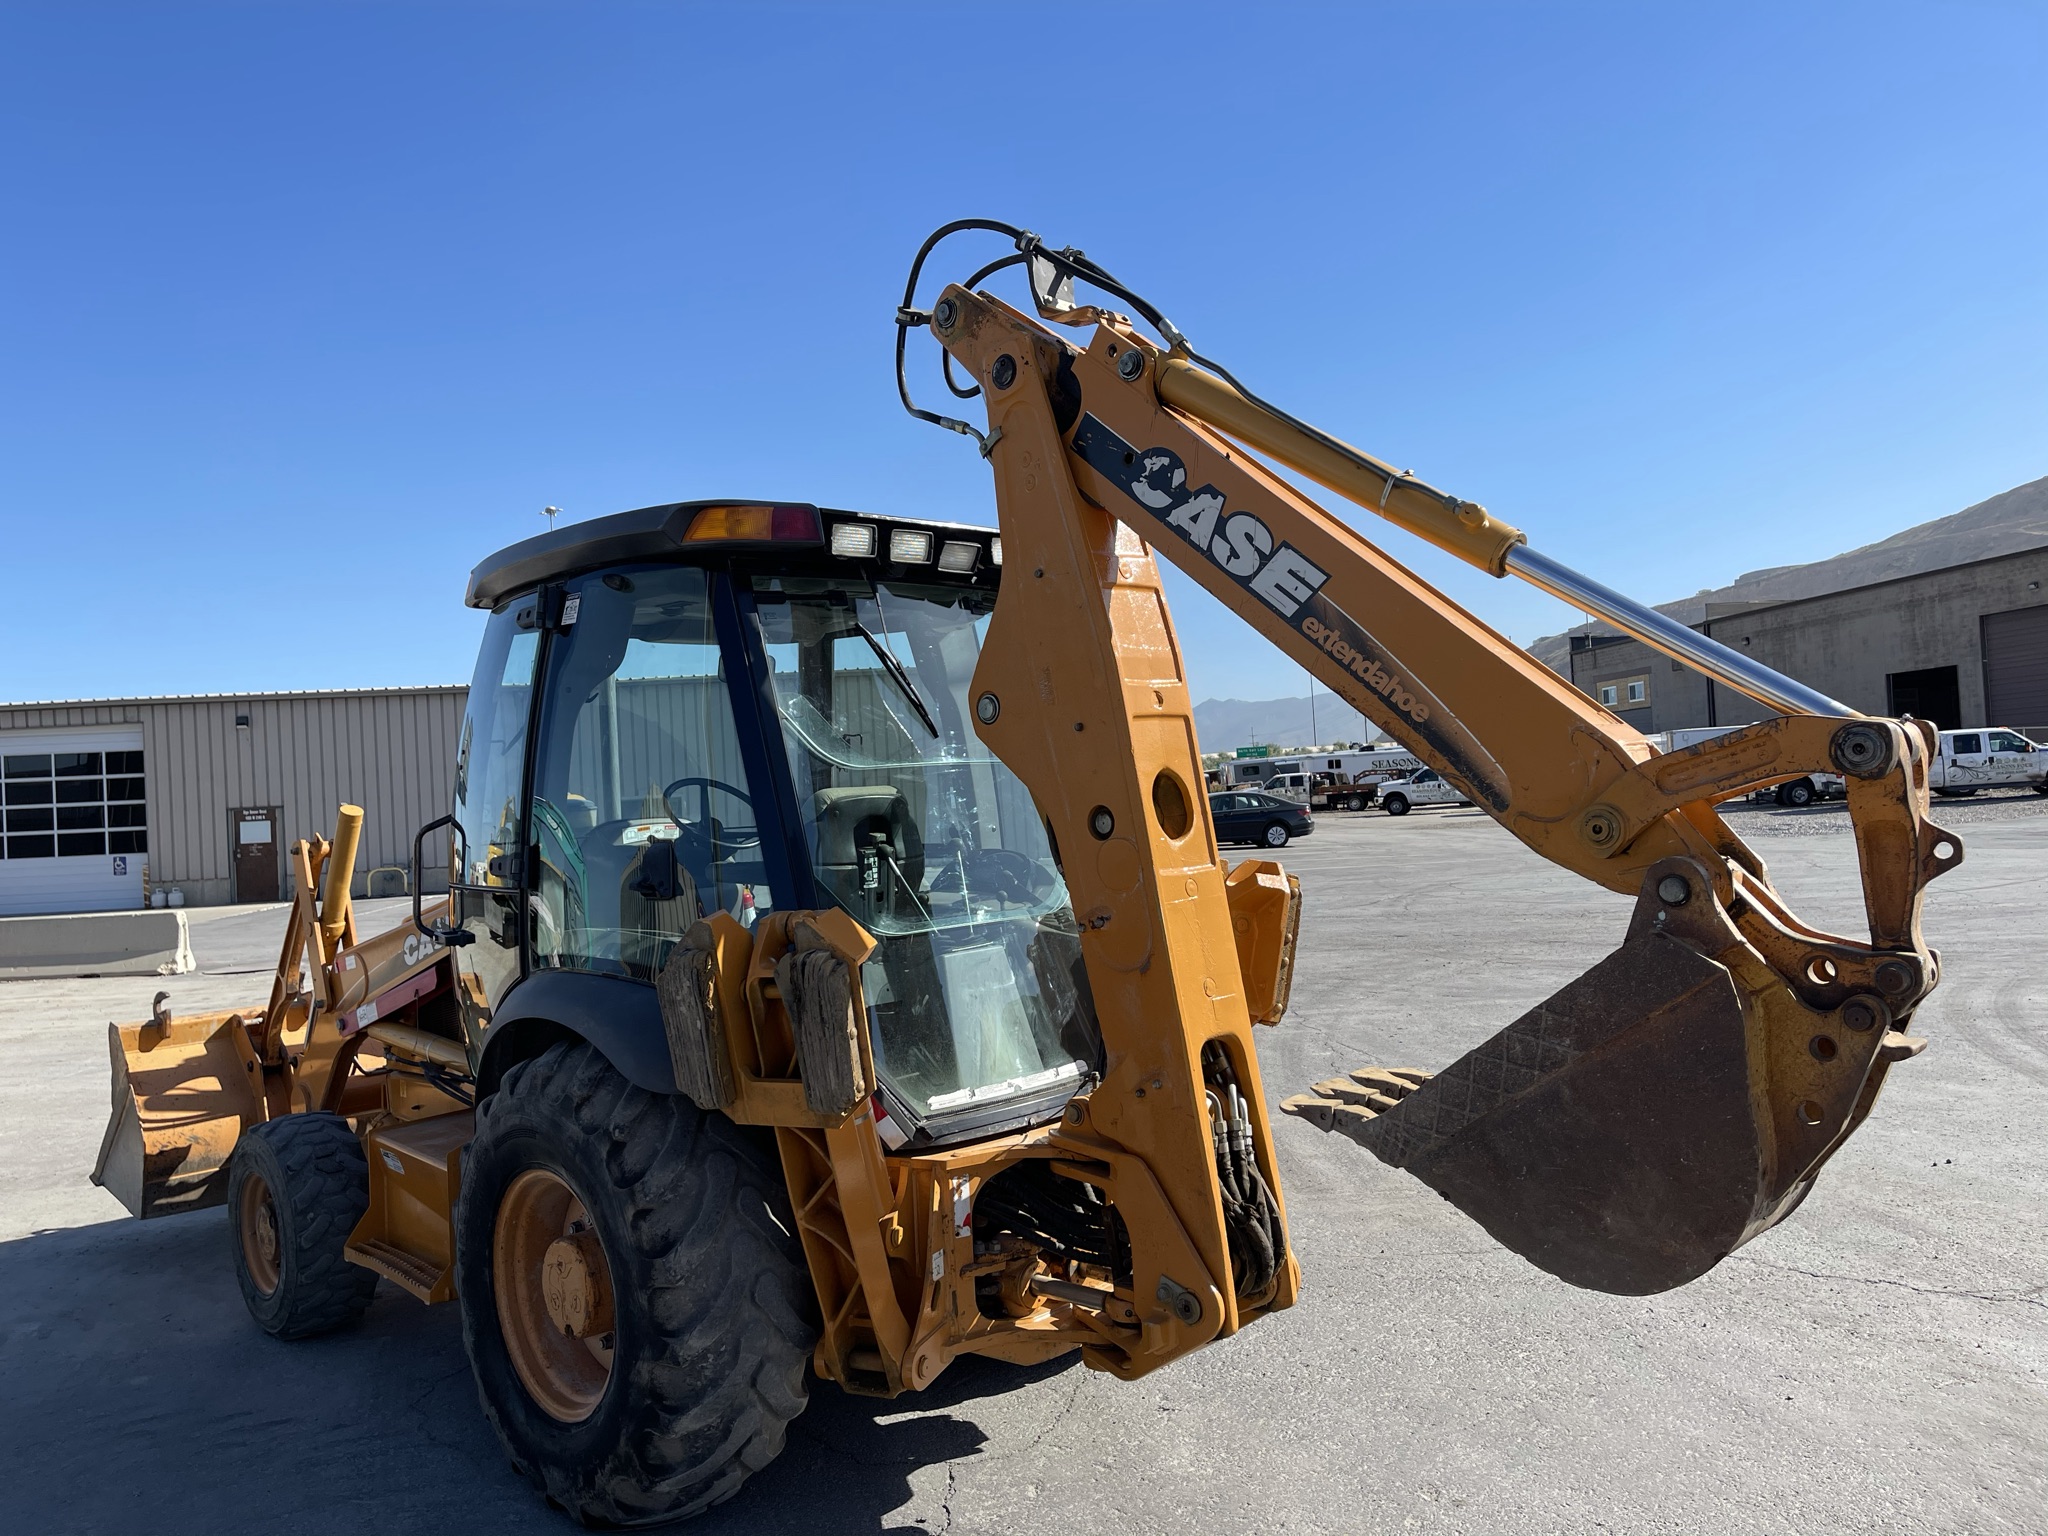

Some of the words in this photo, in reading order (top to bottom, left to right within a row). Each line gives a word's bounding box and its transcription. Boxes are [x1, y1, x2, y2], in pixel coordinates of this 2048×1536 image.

[1131, 456, 1328, 618] CASE
[1301, 616, 1430, 723] extendahoe
[1371, 757, 1420, 769] SEASONS
